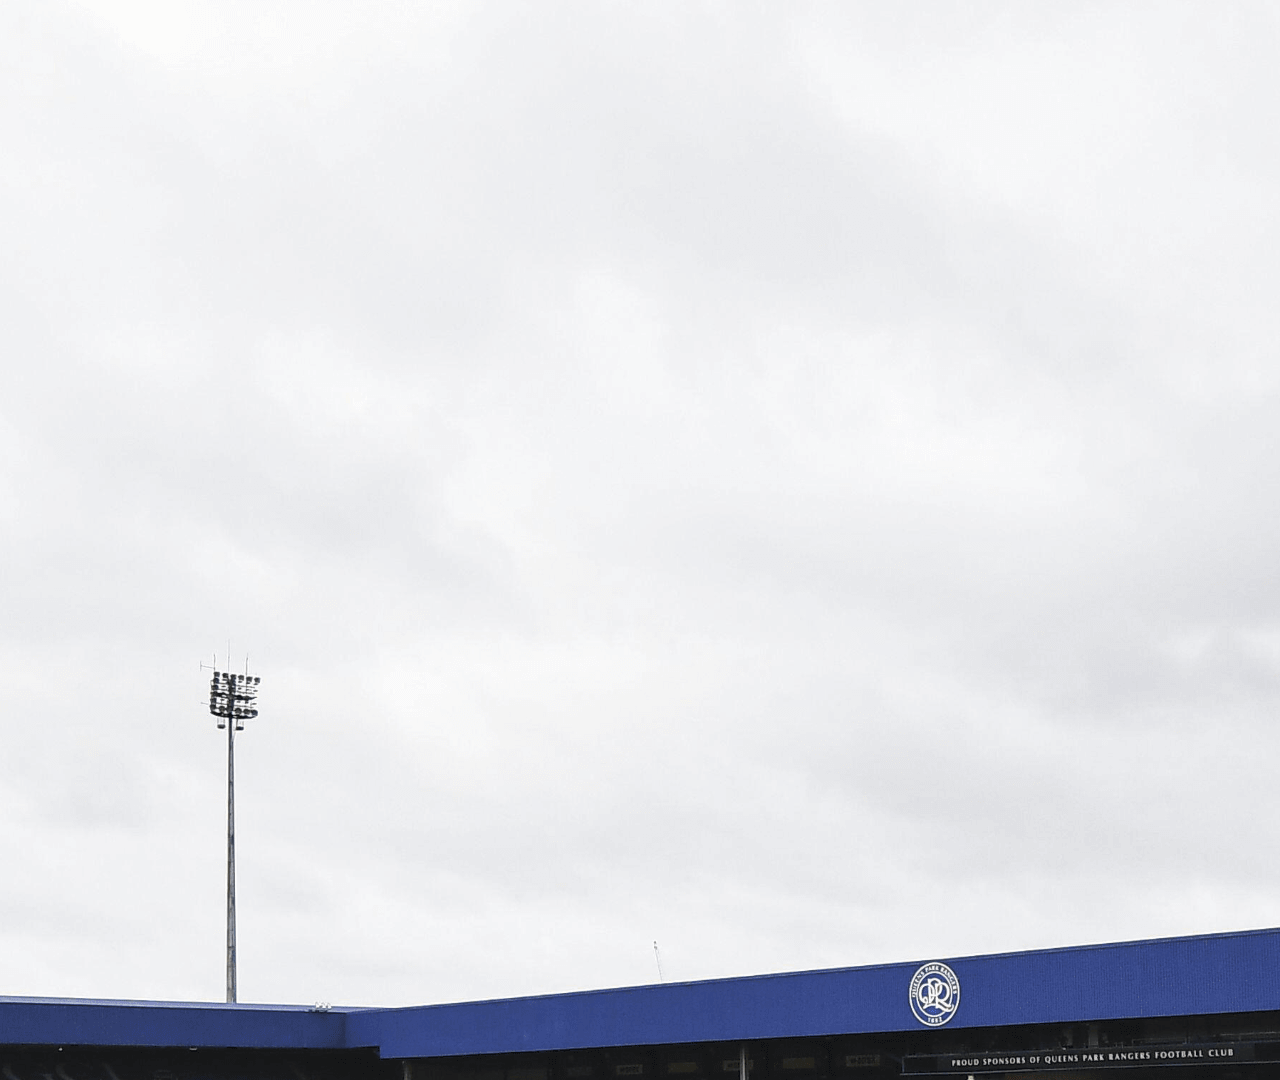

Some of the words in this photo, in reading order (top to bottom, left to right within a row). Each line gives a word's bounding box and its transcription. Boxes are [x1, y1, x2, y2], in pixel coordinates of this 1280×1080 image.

[951, 1058, 980, 1067] PROUD
[982, 1056, 1026, 1066] SPONSORS
[1029, 1055, 1041, 1064] OF
[1044, 1054, 1079, 1064] QUEENS
[1082, 1053, 1105, 1062] PARK
[1108, 1051, 1151, 1061] RANGERS
[1154, 1049, 1204, 1060] FOOTBALL
[1208, 1047, 1234, 1057] CLUB
